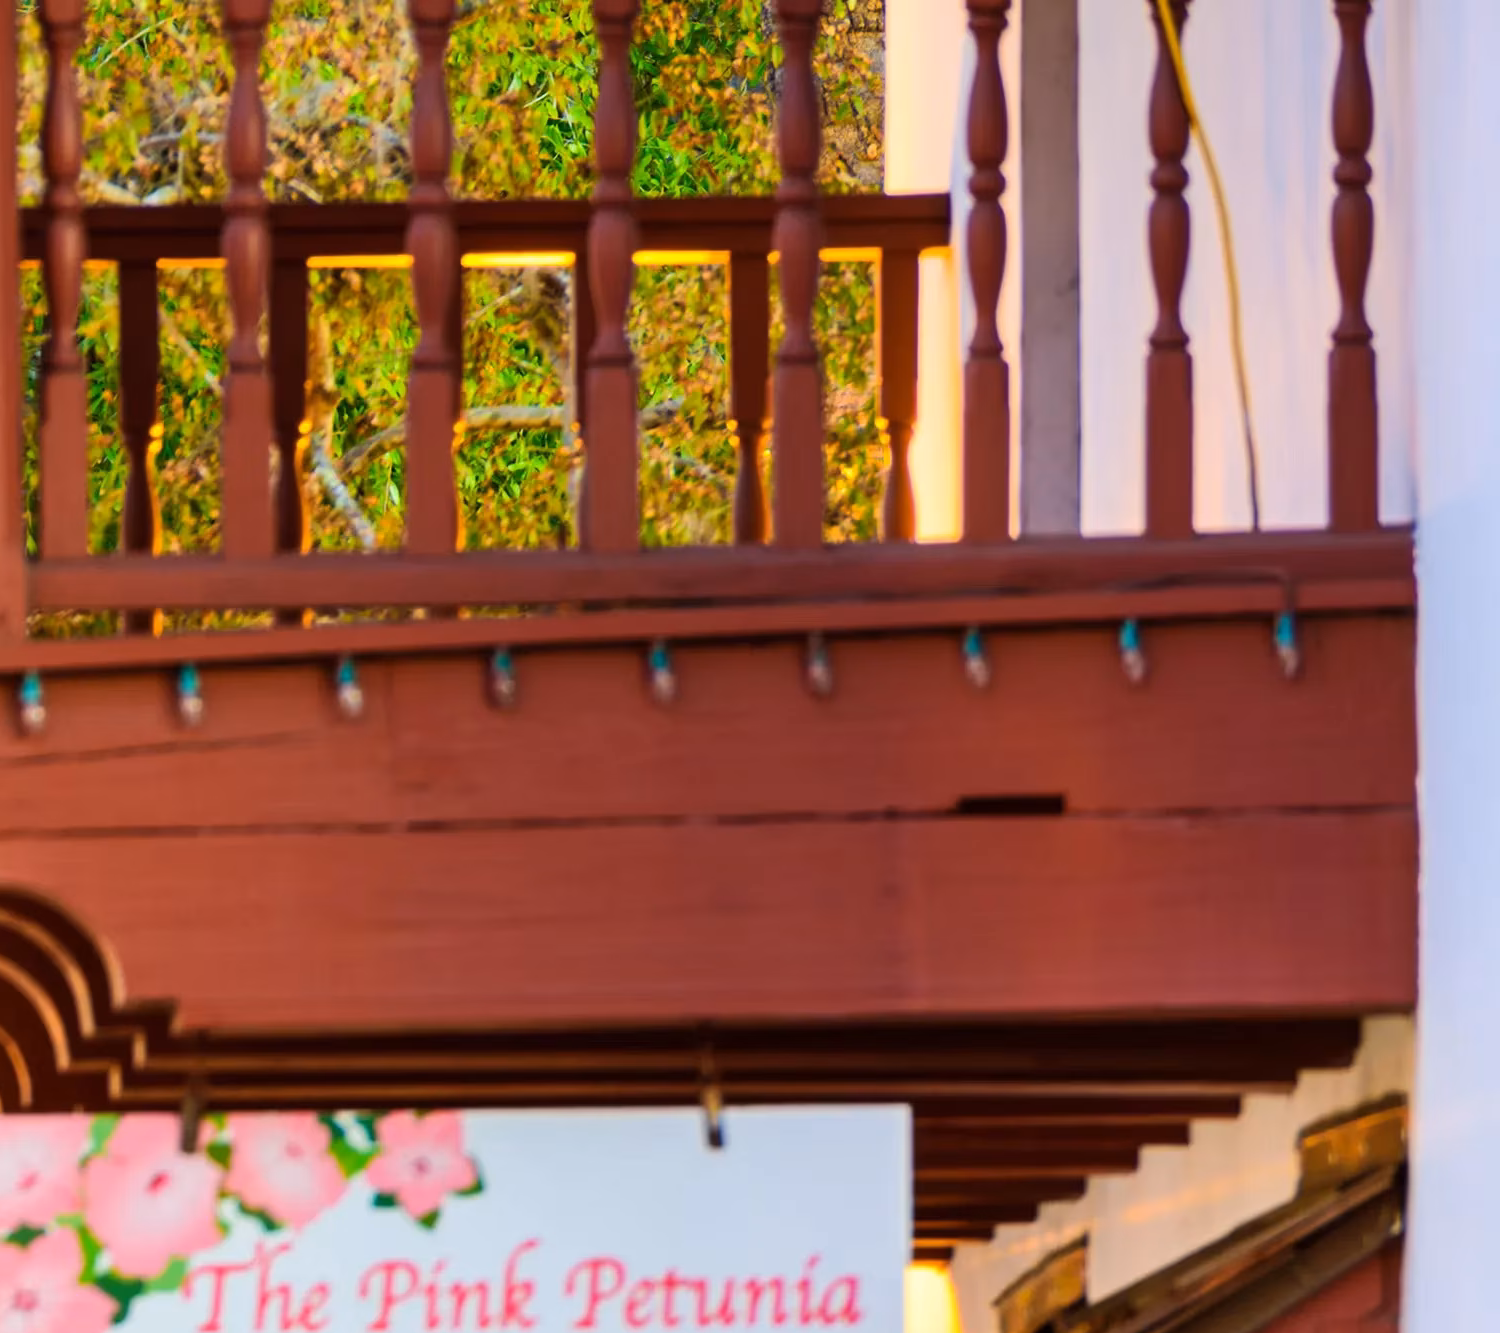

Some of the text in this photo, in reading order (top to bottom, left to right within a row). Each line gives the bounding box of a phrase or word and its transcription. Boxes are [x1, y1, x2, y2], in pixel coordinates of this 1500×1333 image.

[183, 1240, 863, 1333] The Pink Petunia
